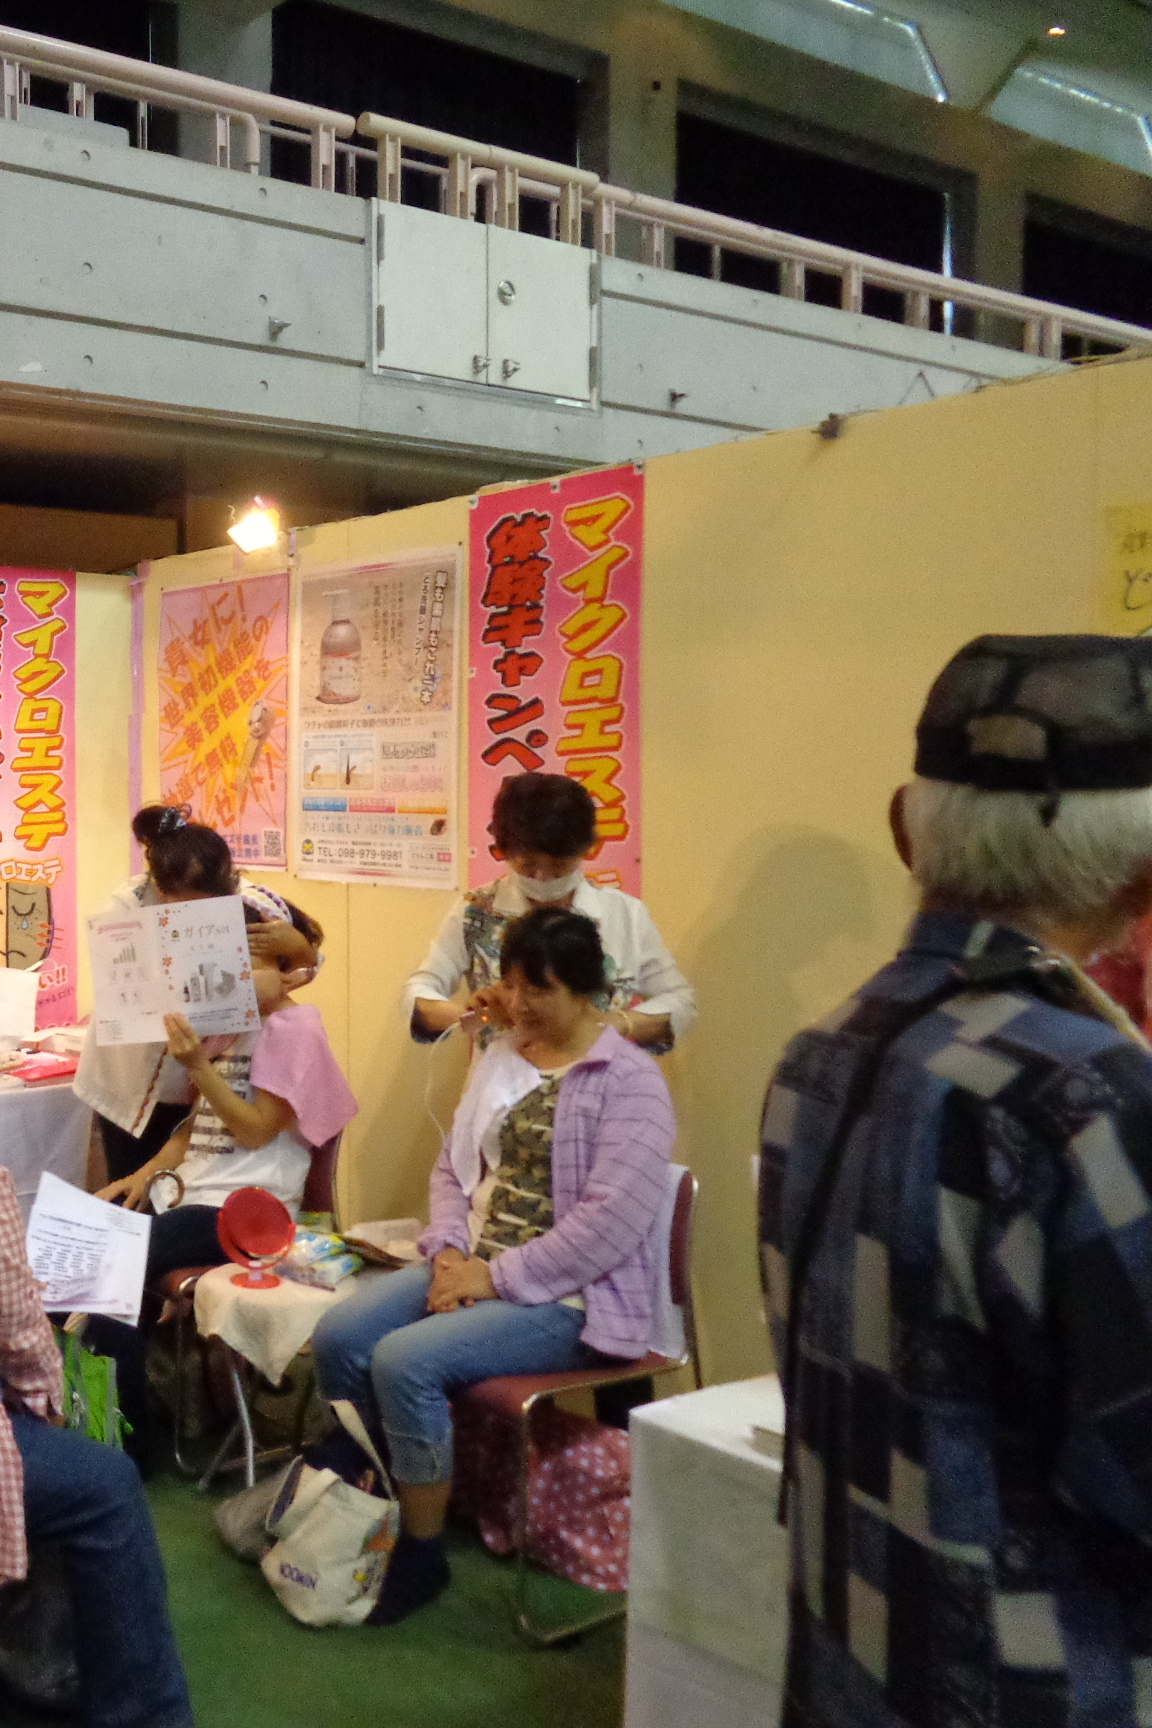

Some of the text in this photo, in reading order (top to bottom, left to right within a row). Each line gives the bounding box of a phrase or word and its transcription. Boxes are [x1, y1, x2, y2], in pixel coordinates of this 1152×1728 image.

[11, 580, 67, 850] マイクロエステ
